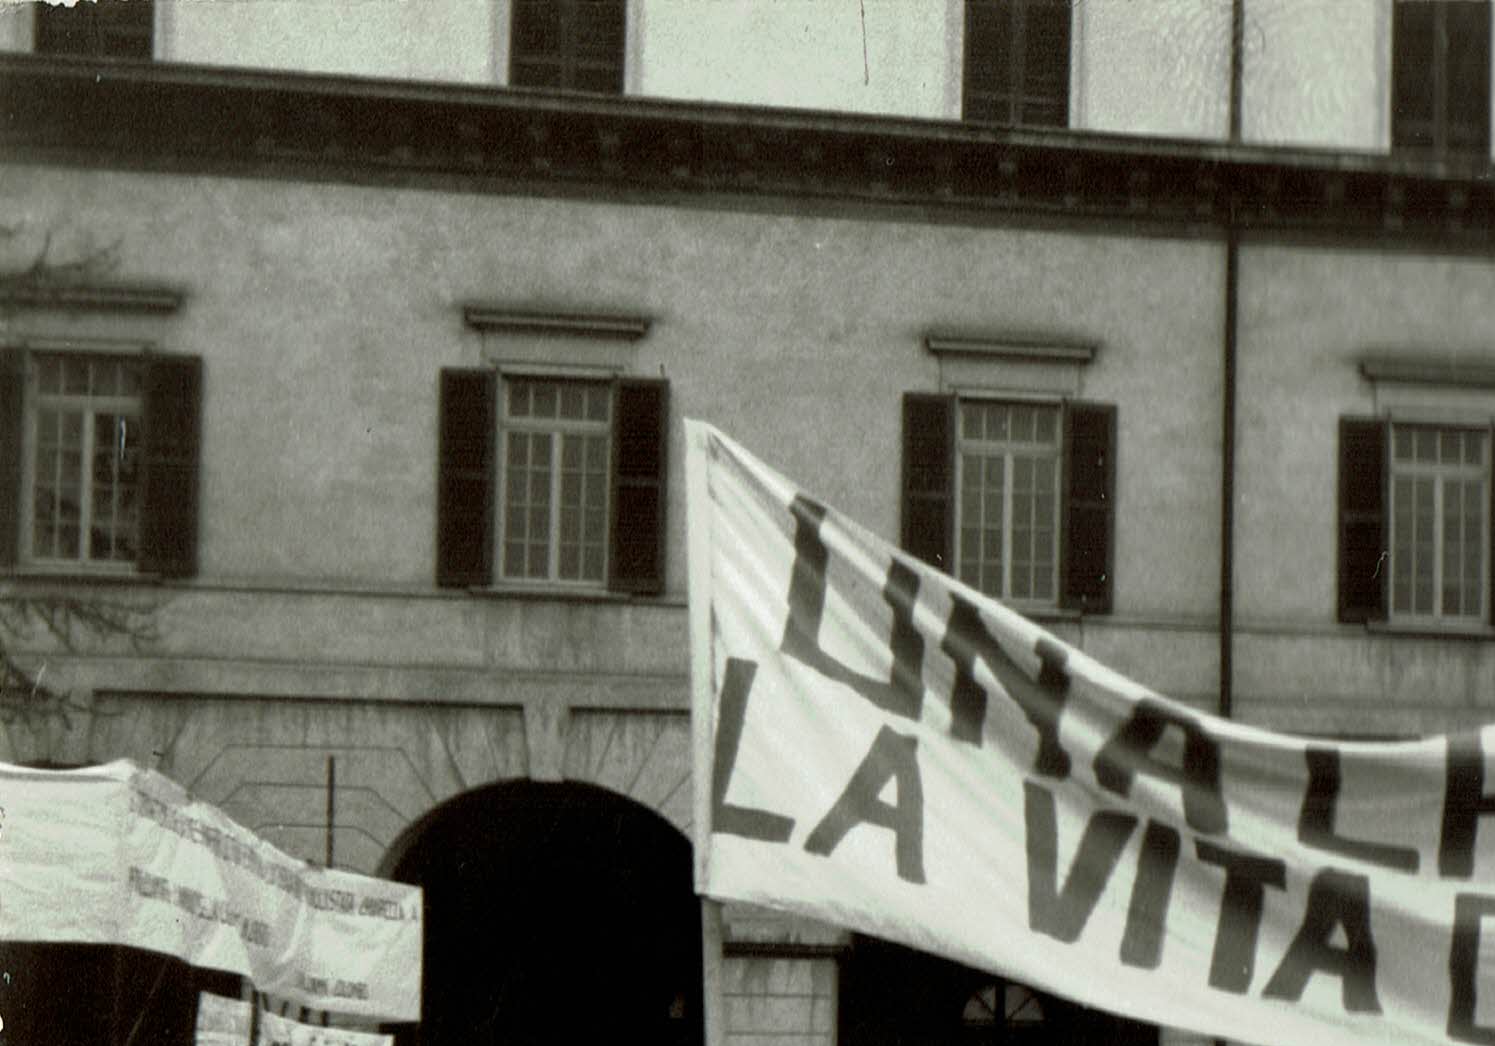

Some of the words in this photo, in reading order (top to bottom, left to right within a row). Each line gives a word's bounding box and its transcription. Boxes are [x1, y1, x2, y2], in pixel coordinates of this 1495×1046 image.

[711, 656, 928, 885] LA
[1024, 778, 1383, 1014] VITA
[780, 494, 1228, 836] UNA
